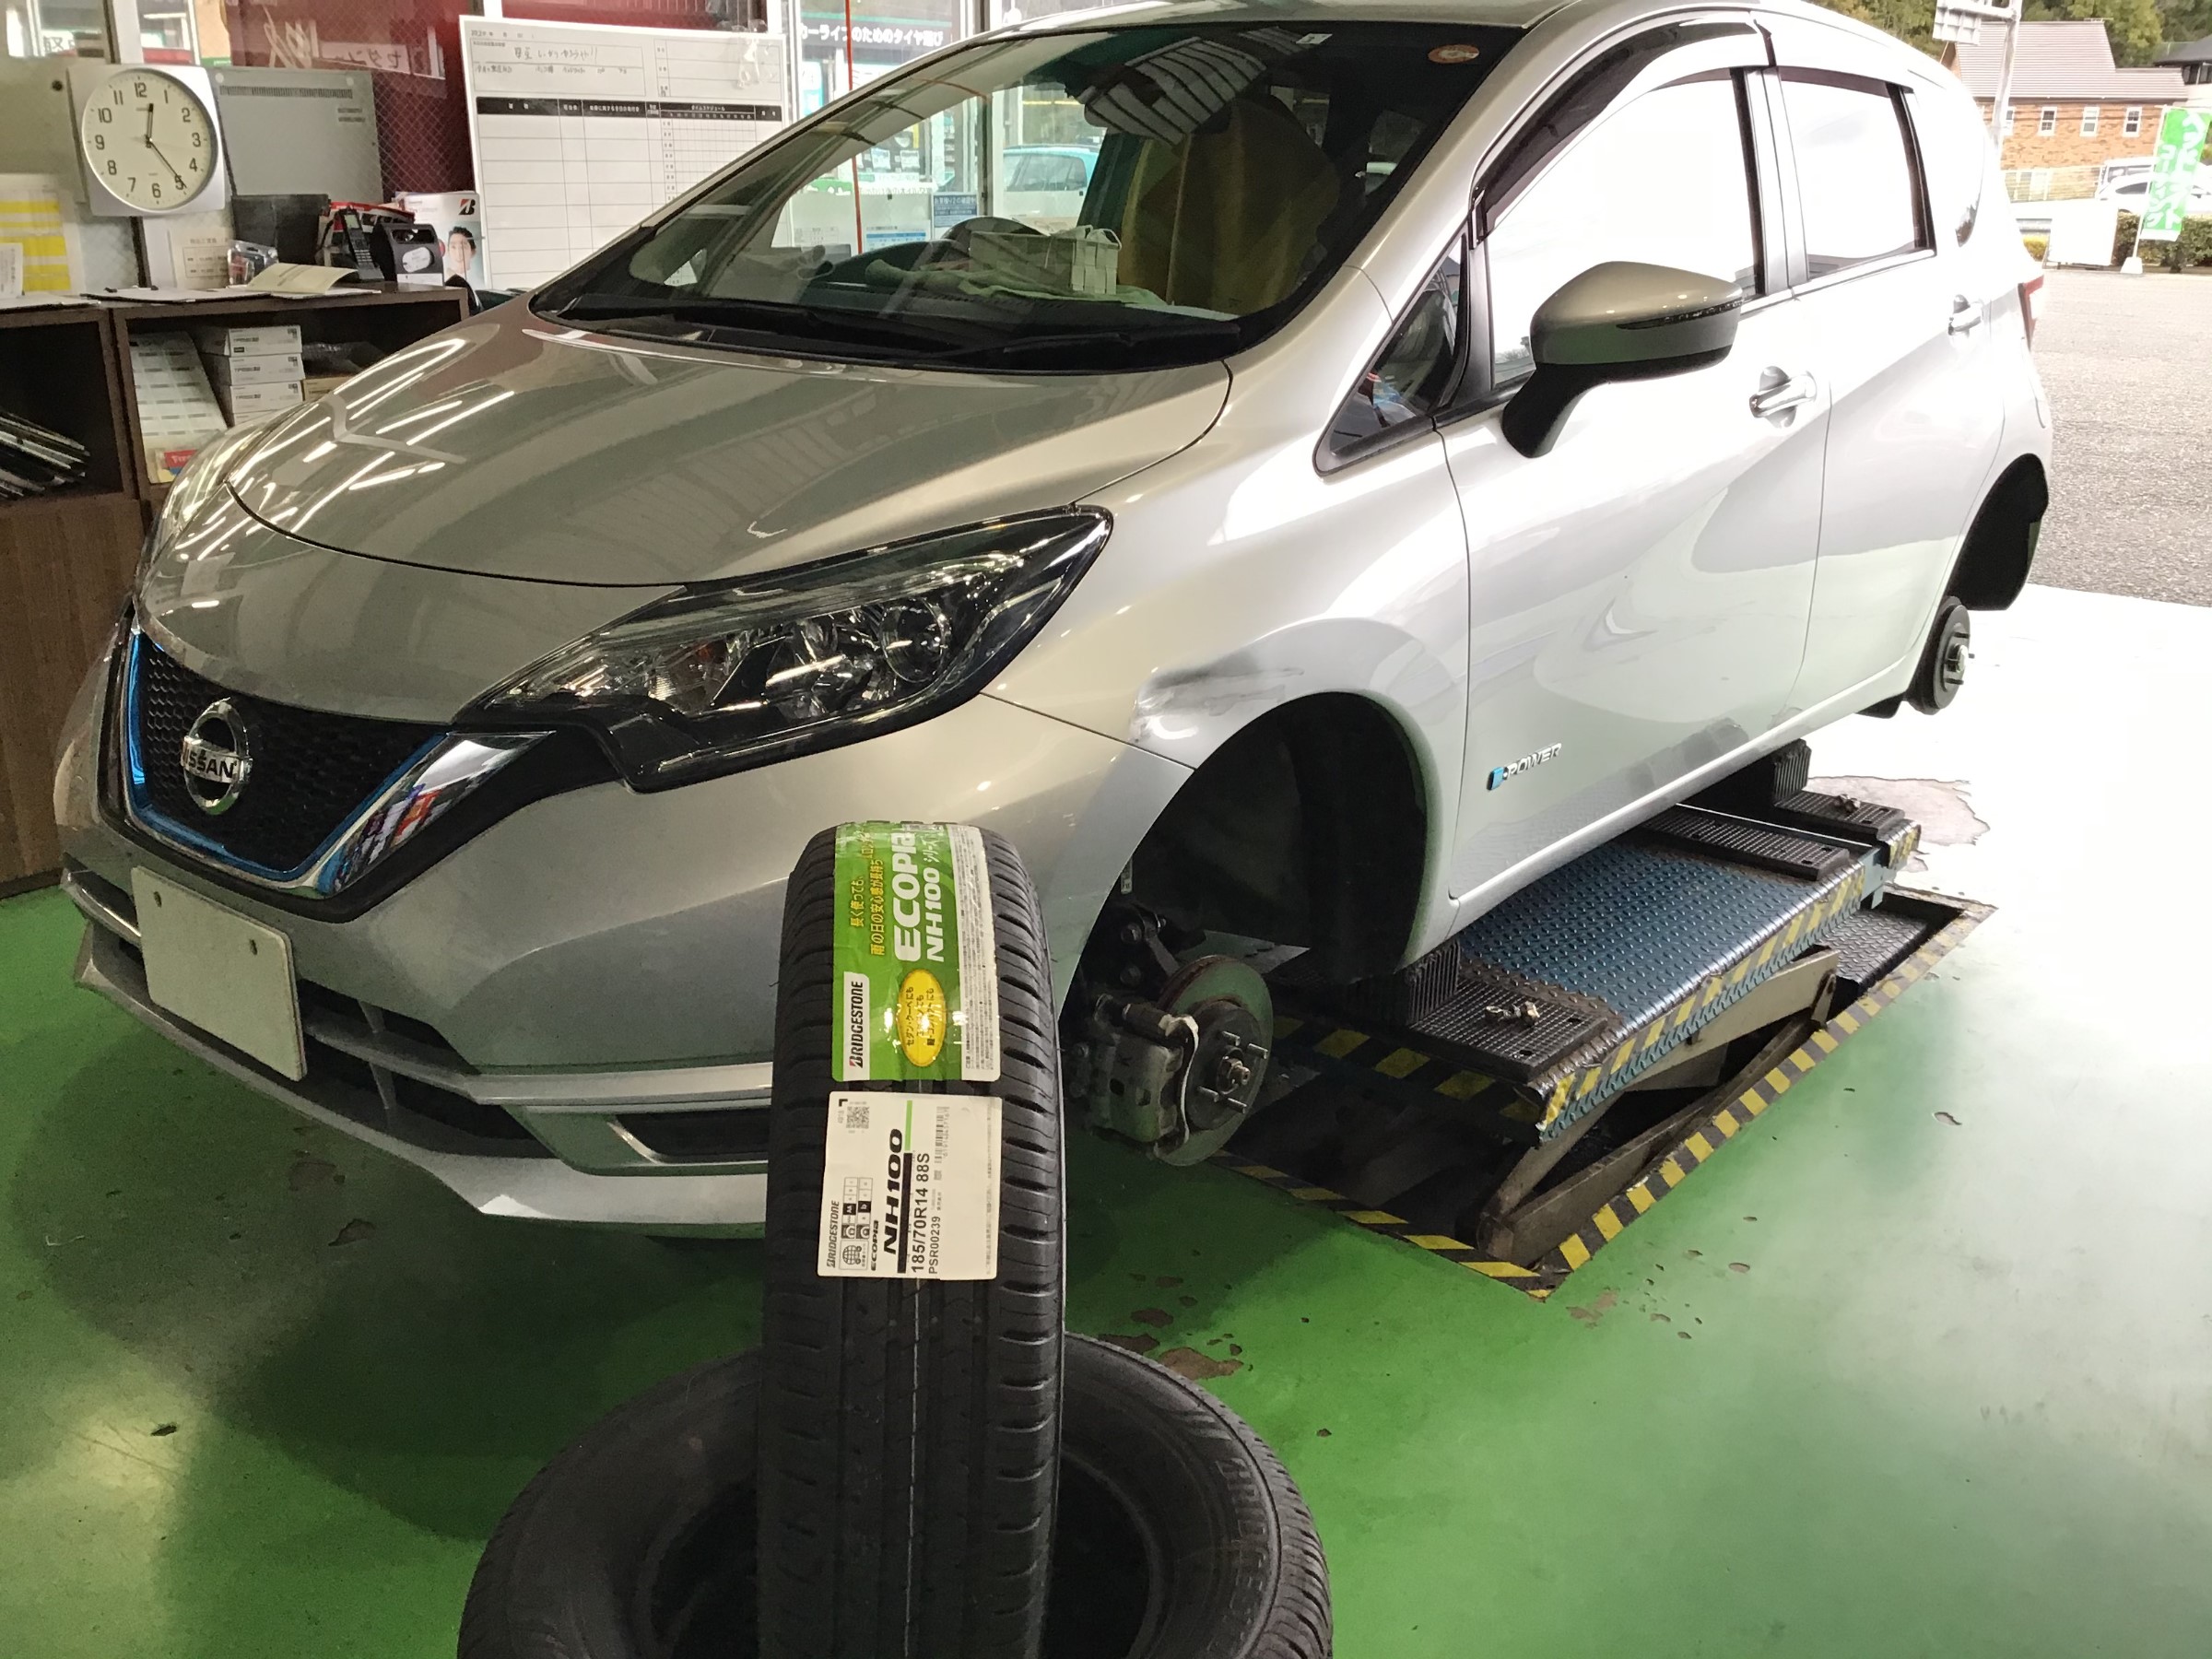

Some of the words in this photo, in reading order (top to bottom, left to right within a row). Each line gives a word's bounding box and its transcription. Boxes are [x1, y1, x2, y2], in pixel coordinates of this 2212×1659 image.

[114, 89, 124, 105] 11
[135, 82, 147, 98] 12
[164, 89, 169, 103] 1
[98, 107, 112, 124] 10
[182, 108, 192, 123] 2
[95, 135, 105, 150] 9
[192, 132, 202, 147] 3
[107, 159, 117, 175] 8
[189, 158, 198, 172] 4
[128, 177, 137, 193] 7
[152, 182, 161, 198] 6
[175, 175, 185, 190] 5
[849, 875, 865, 927] 長く使っても、
[870, 859, 886, 956] 雨の日の安心感が長持ち
[923, 866, 945, 963] NH100
[848, 980, 865, 1069] BRIDGESTONE
[905, 986, 915, 1047] セダン・クーペにも
[916, 1152, 930, 1183] 88S
[883, 1128, 903, 1255] NH100
[826, 1200, 840, 1269] BRIDGESTONE
[911, 1187, 930, 1274] 185/70R14
[928, 1216, 941, 1275] PSR00239
